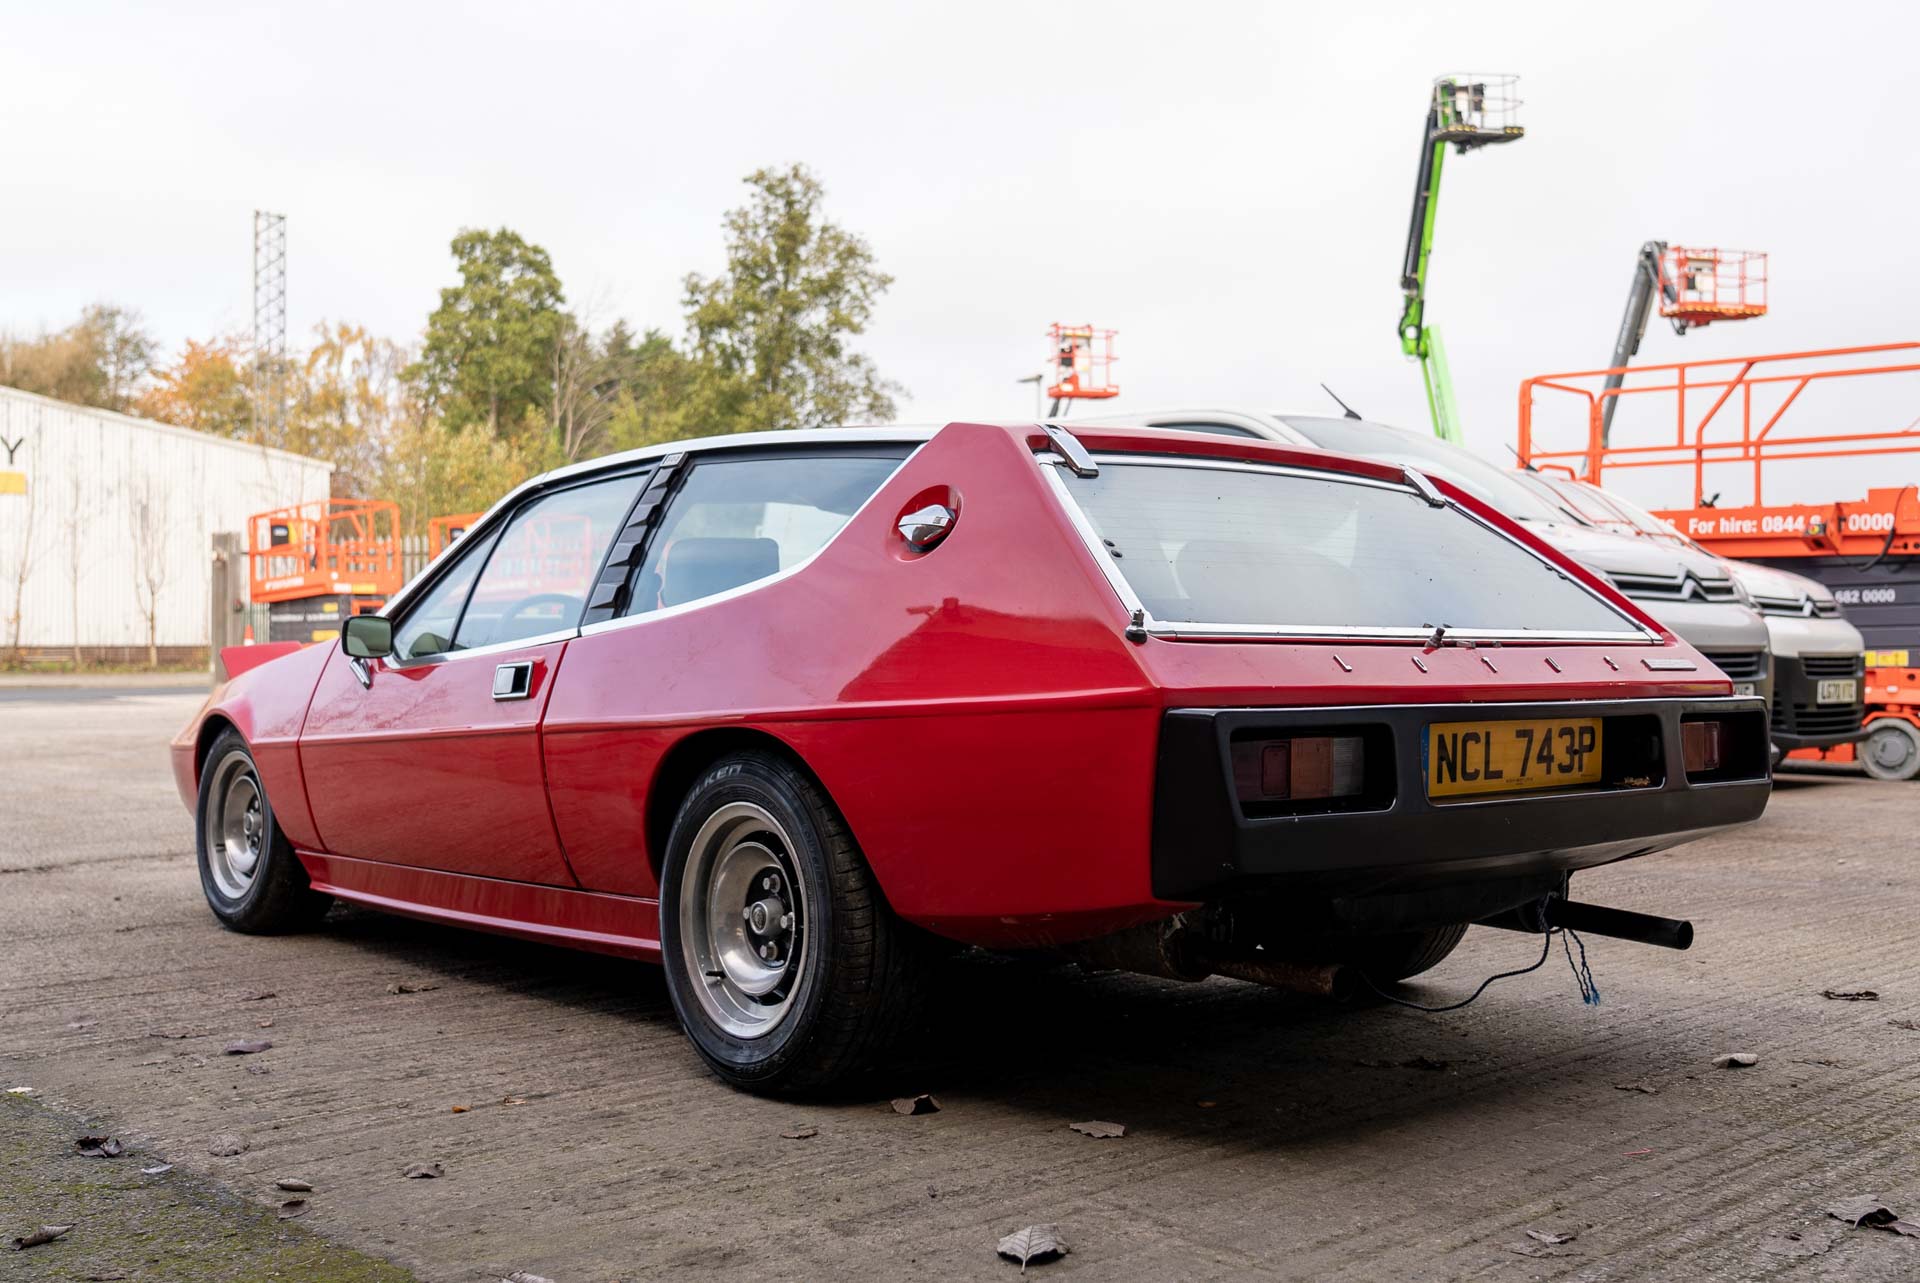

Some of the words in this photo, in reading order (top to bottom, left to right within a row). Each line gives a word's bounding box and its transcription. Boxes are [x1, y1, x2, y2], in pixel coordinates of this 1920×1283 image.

[1688, 517, 1716, 534] For
[1720, 516, 1758, 533] hire:
[1761, 515, 1805, 532] 0844
[1848, 513, 1895, 531] 0000
[1862, 588, 1896, 603] 0000
[1333, 655, 1620, 673] LOTUS
[1436, 731, 1503, 784] NCL
[1515, 726, 1595, 777] 743P
